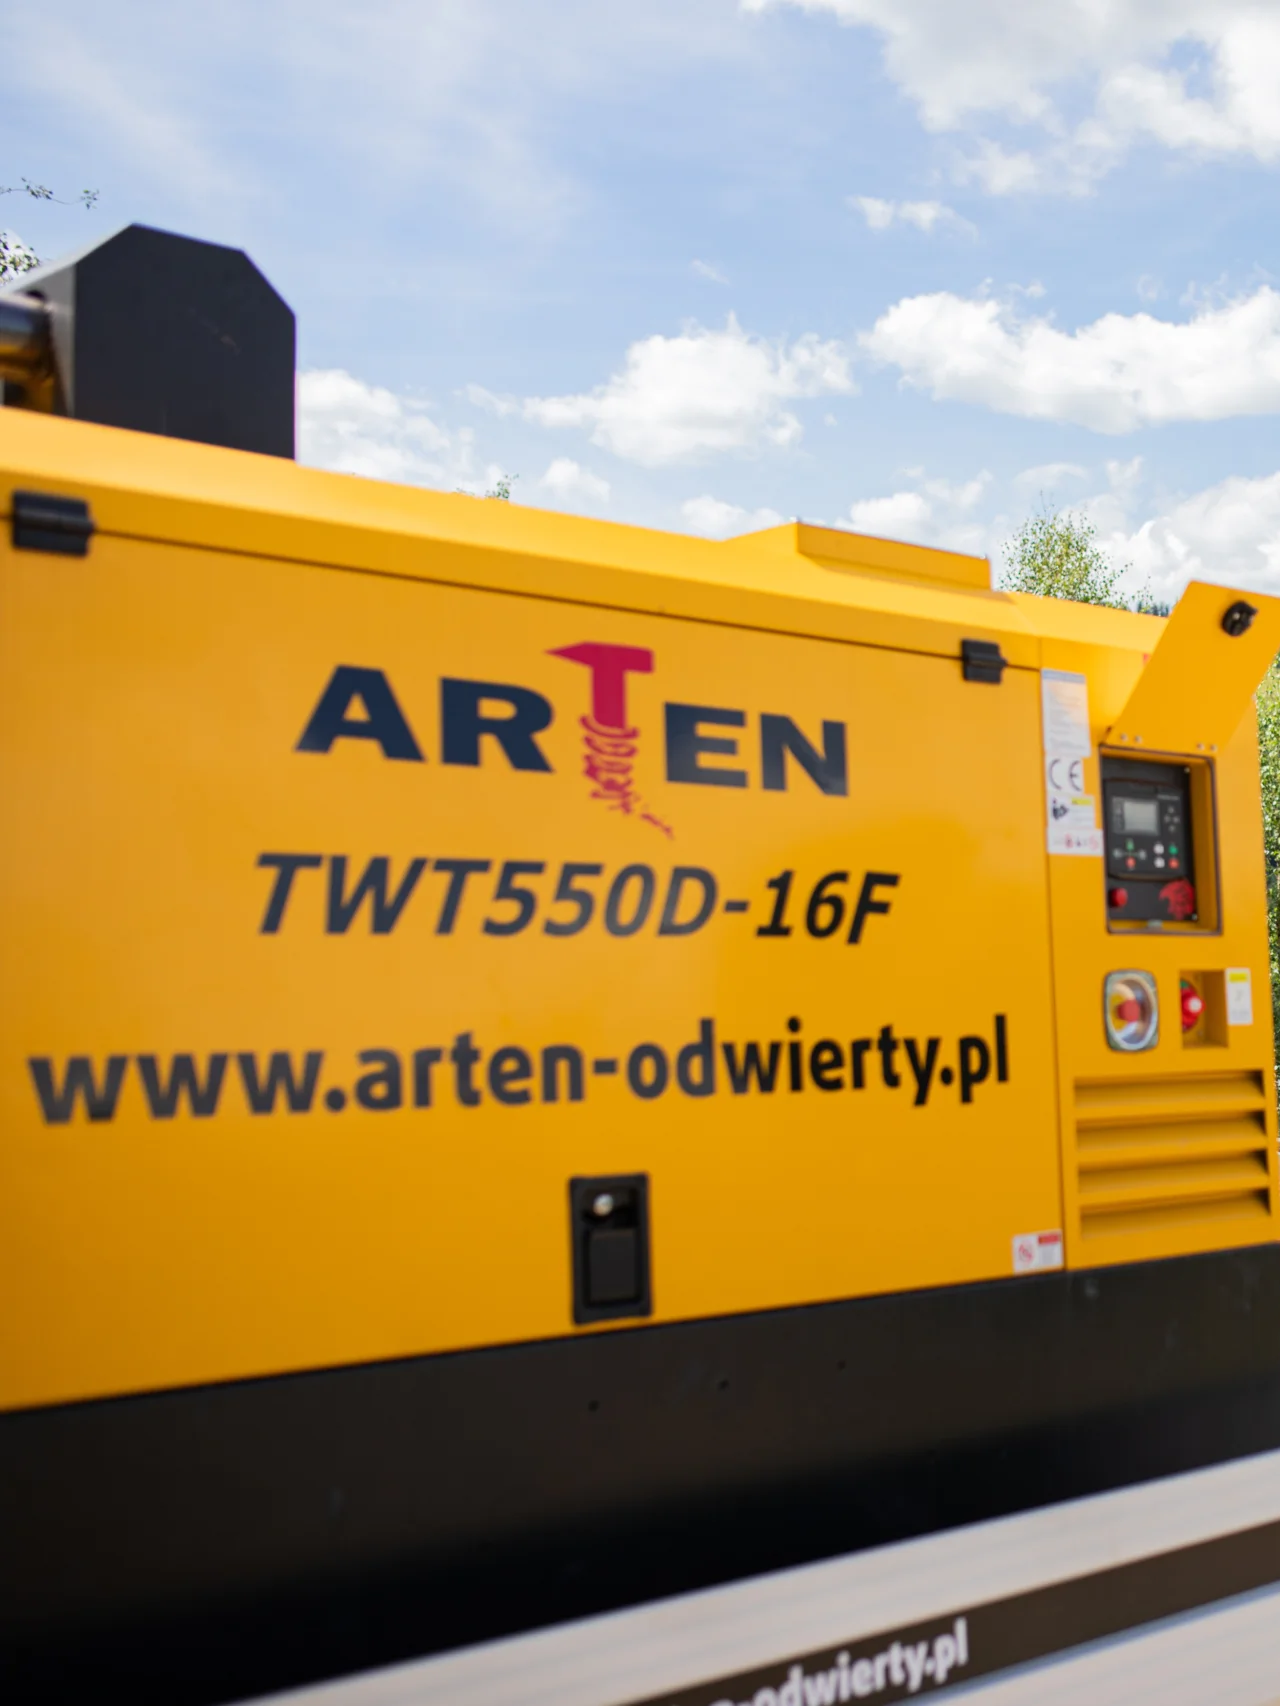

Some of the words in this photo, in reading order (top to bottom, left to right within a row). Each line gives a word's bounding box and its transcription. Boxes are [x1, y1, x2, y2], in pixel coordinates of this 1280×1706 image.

[295, 641, 849, 838] ARTEN
[256, 852, 901, 945] TWT550D-16F
[27, 1013, 1009, 1126] www.arten-odwierty.pl
[709, 1616, 968, 1706] odwierty.pl
